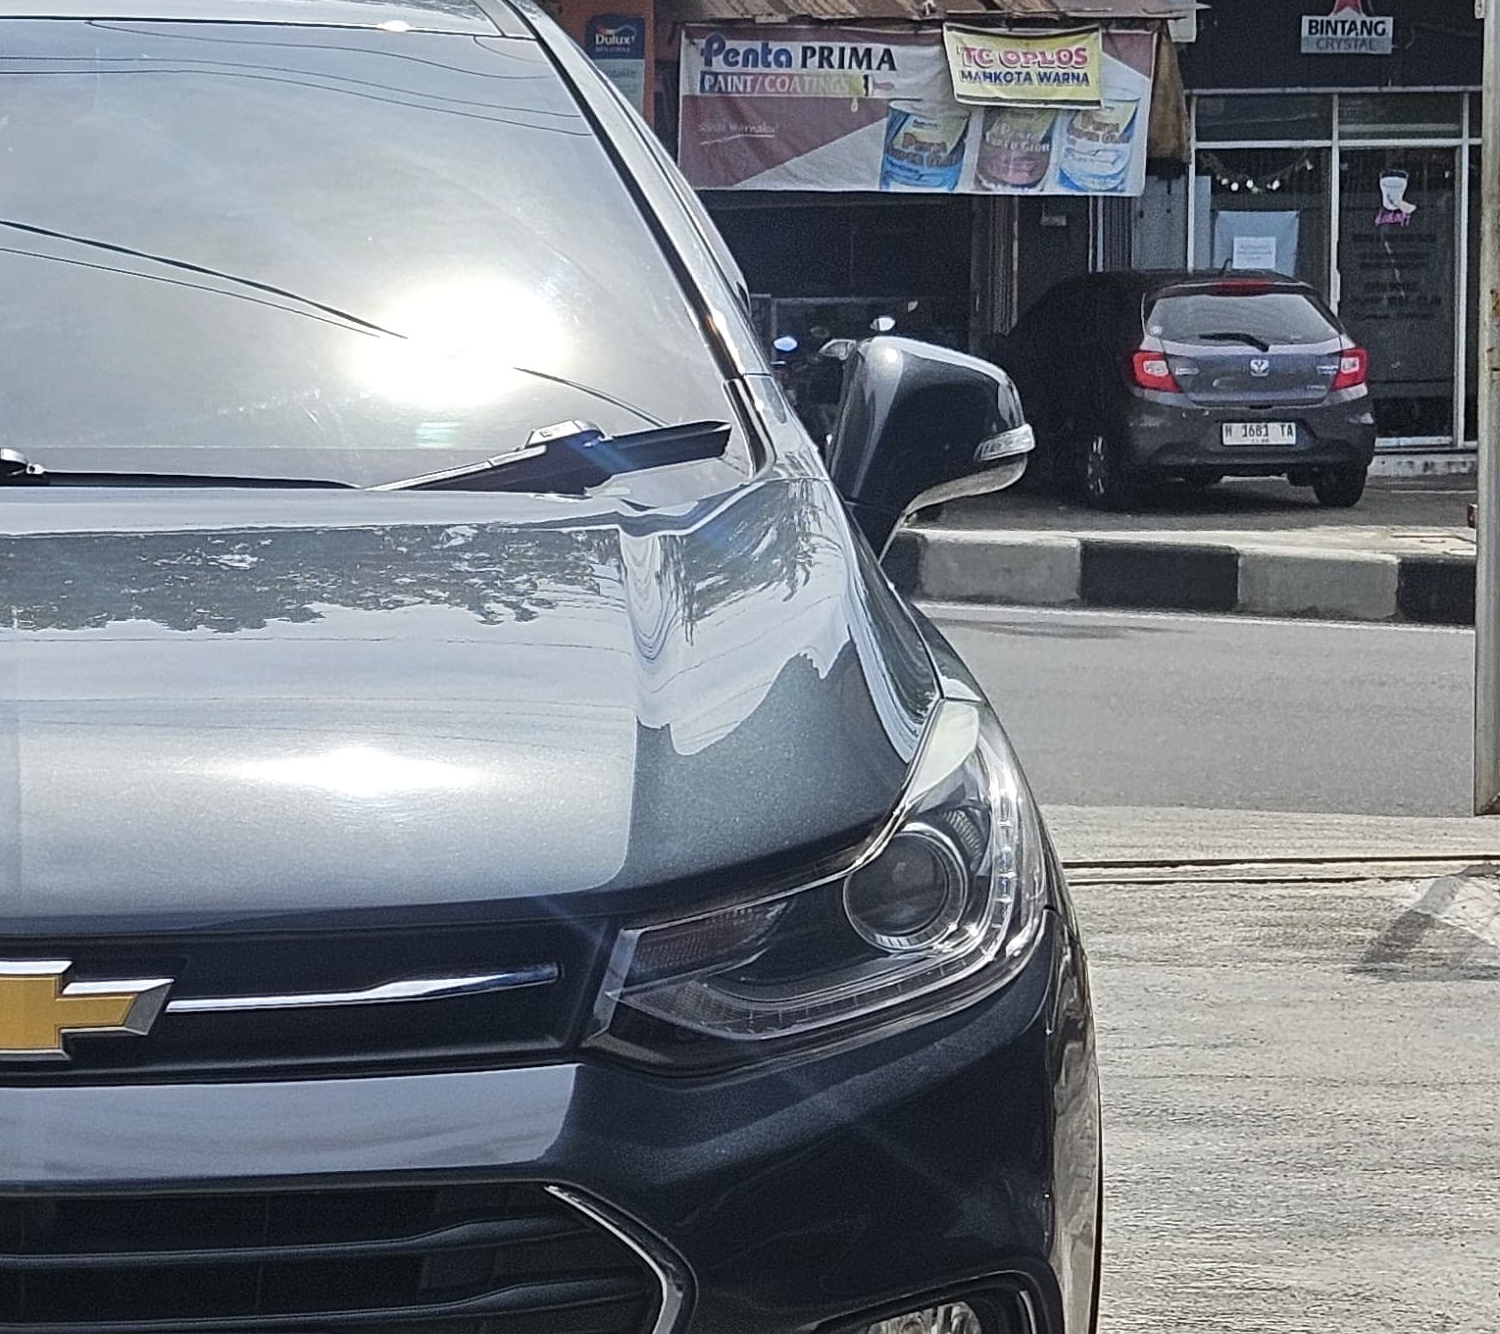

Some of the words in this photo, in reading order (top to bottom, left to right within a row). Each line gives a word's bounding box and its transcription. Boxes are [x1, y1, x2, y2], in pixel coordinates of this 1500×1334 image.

[1307, 18, 1387, 37] BINTANG
[595, 33, 631, 45] Dulux
[1315, 36, 1377, 51] CRYSTAL
[702, 32, 793, 68] Penta
[800, 45, 898, 72] PRIMA
[999, 46, 1089, 69] OPLOS
[703, 73, 848, 94] PAINT/COATINGS
[1037, 70, 1090, 86] WARNA
